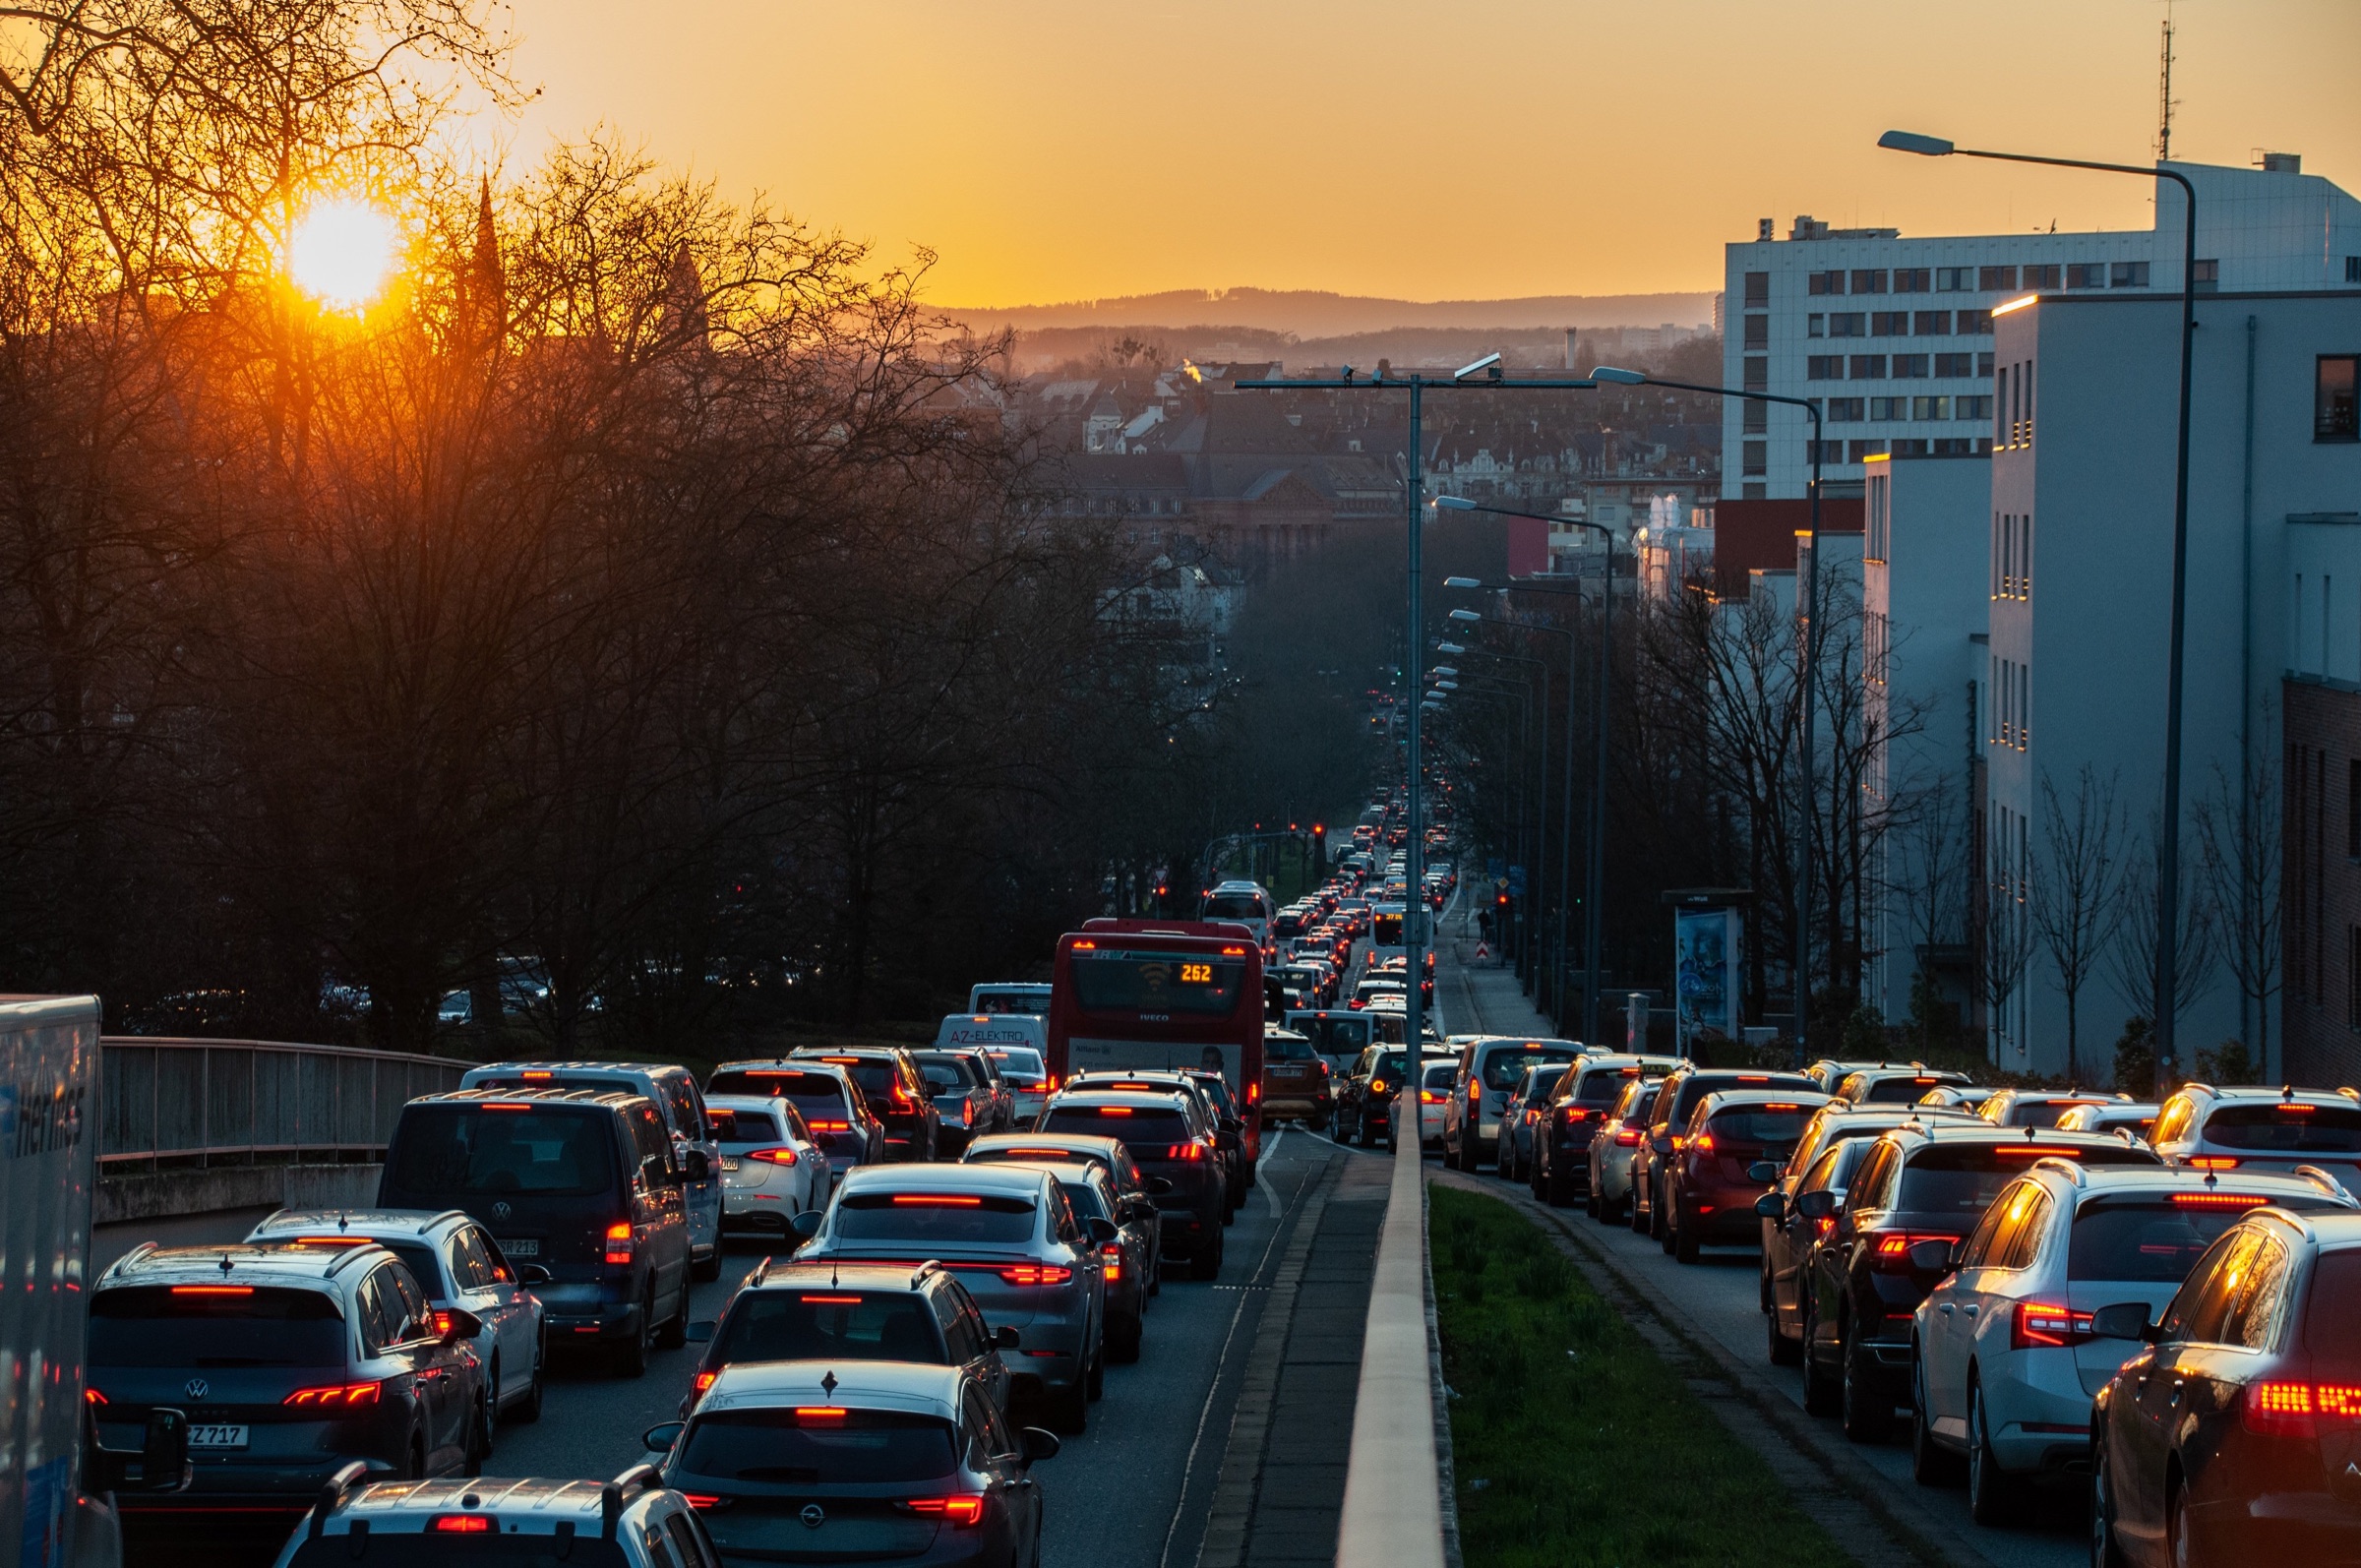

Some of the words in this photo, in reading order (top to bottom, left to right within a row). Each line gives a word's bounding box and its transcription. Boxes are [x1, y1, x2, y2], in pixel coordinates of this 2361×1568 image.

[1181, 964, 1212, 982] 262
[1140, 1013, 1170, 1022] IVECO
[516, 1240, 537, 1253] 213
[208, 1426, 240, 1443] 717
